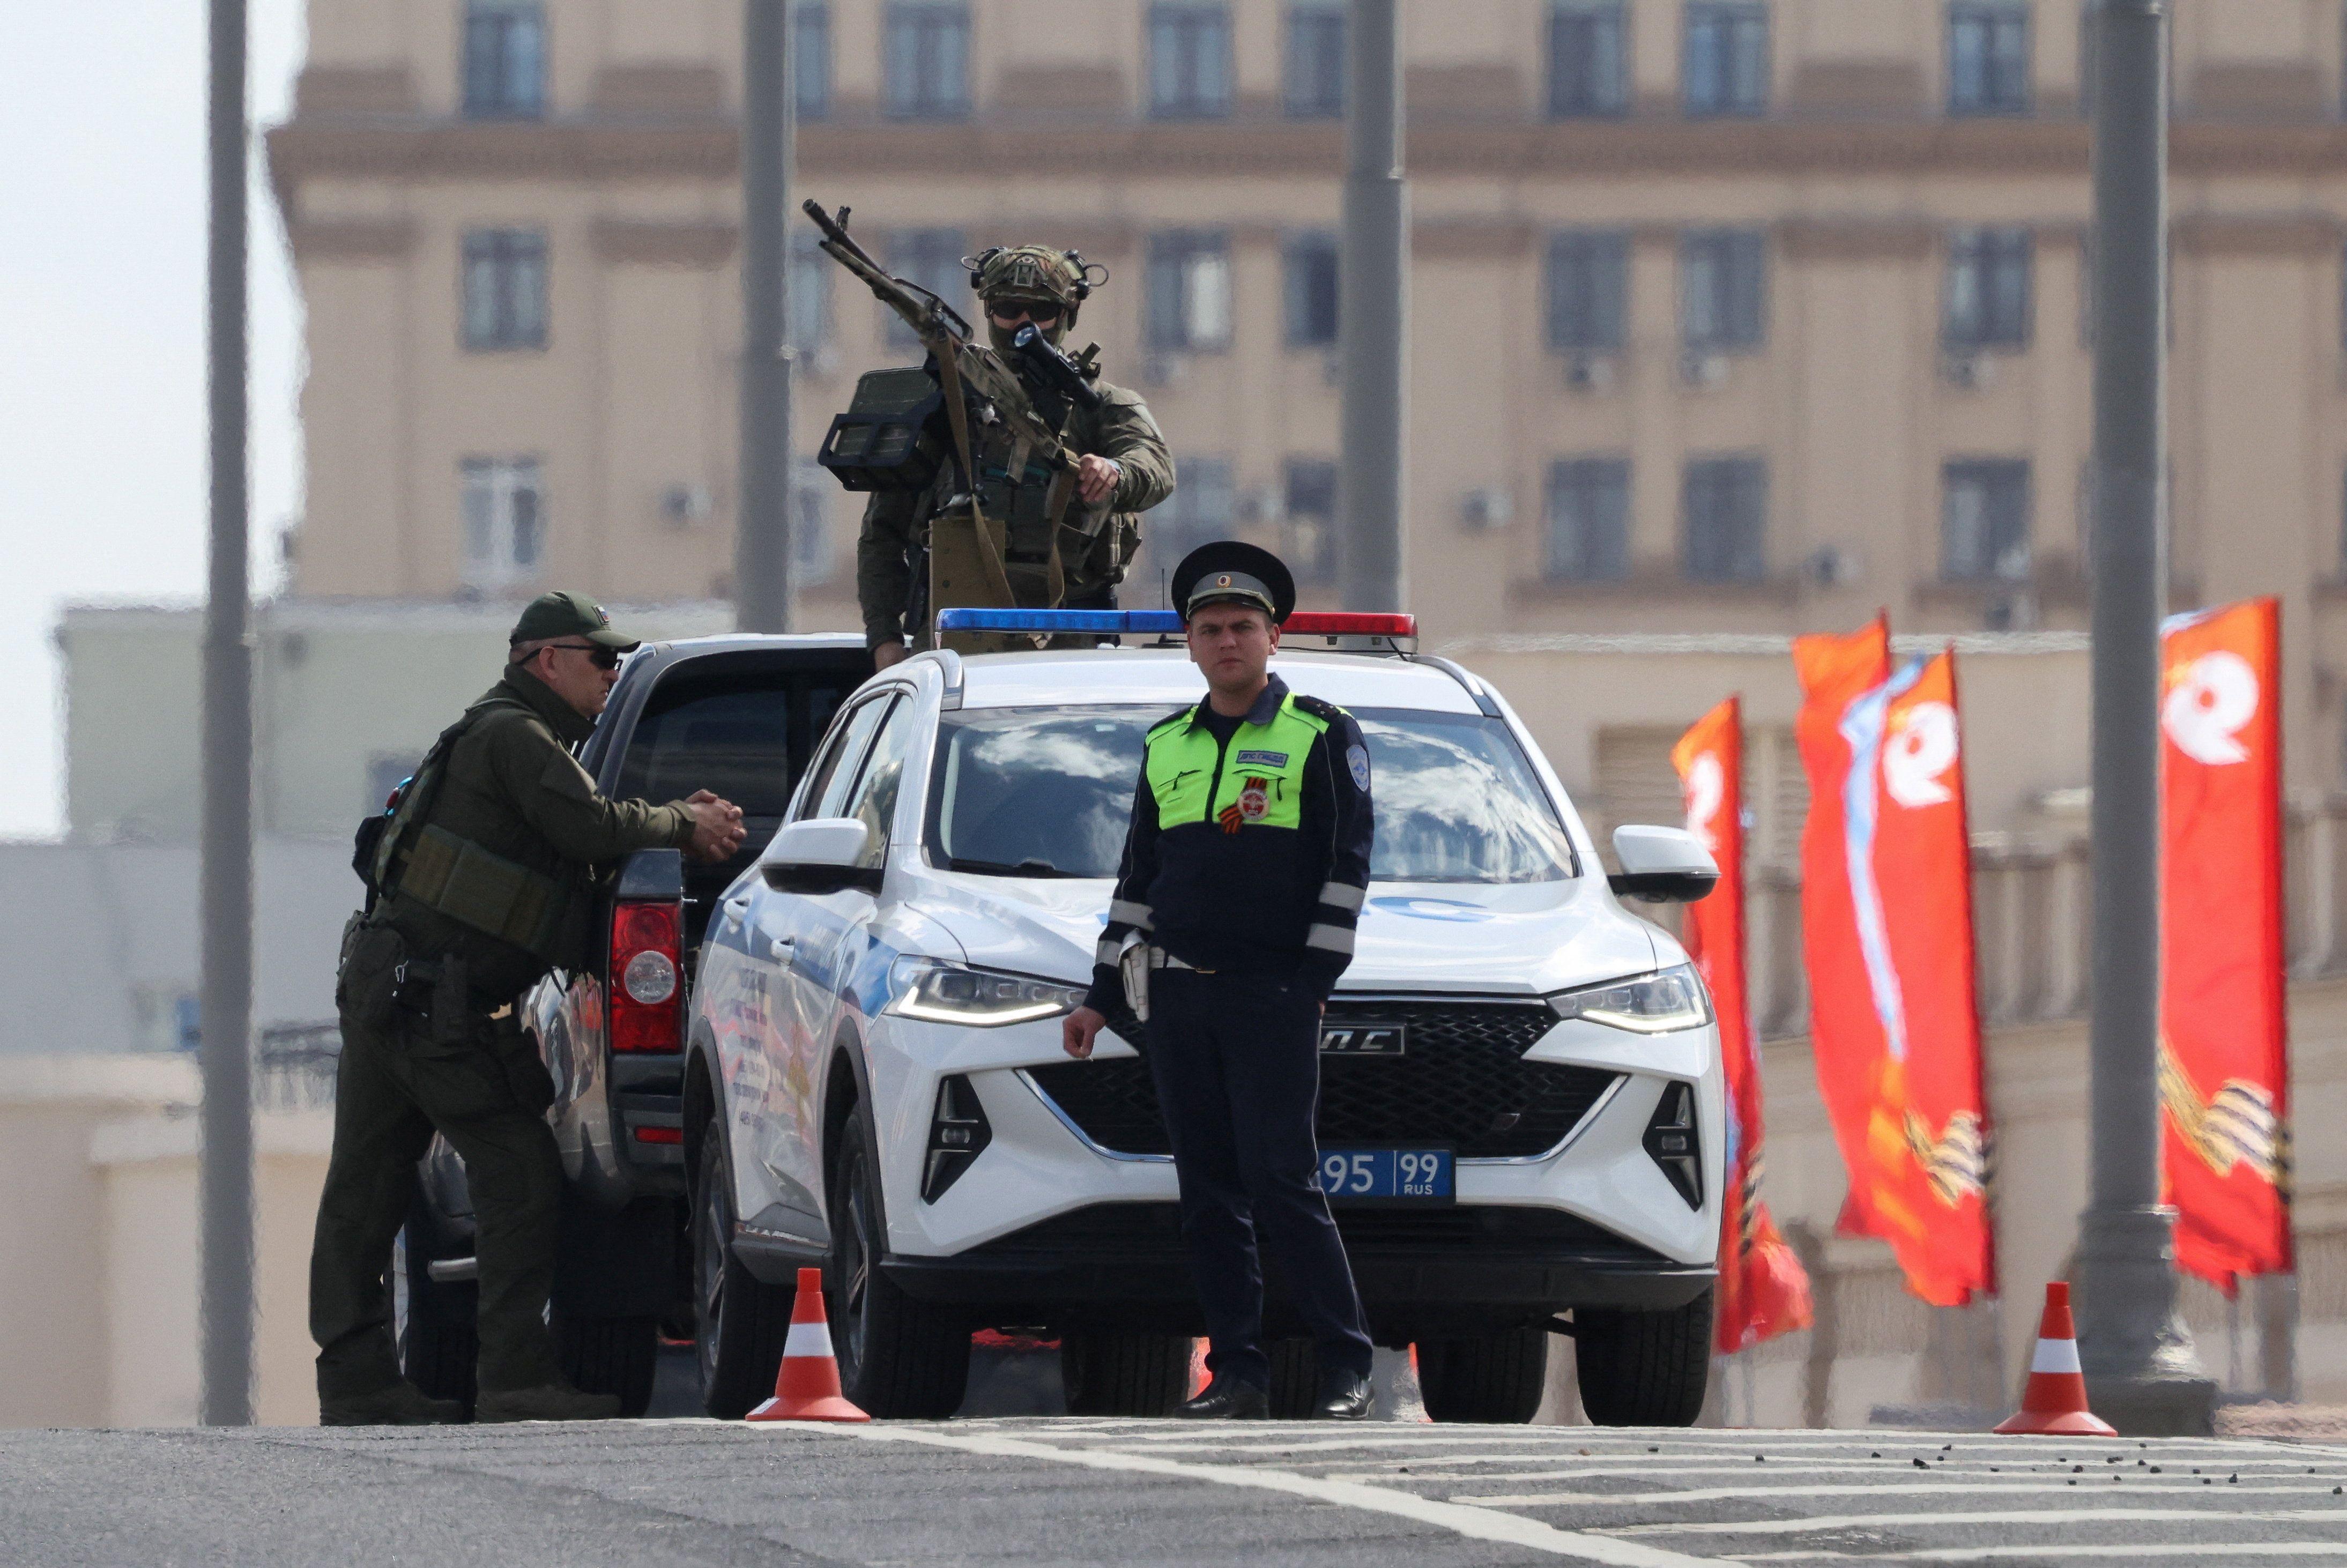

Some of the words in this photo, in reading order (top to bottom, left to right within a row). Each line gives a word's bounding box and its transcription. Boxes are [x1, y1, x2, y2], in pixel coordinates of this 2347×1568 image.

[1319, 1030, 1392, 1050] ПС
[1324, 1154, 1374, 1193] 95
[1400, 1154, 1439, 1183] 99
[1403, 1184, 1433, 1195] RUS
